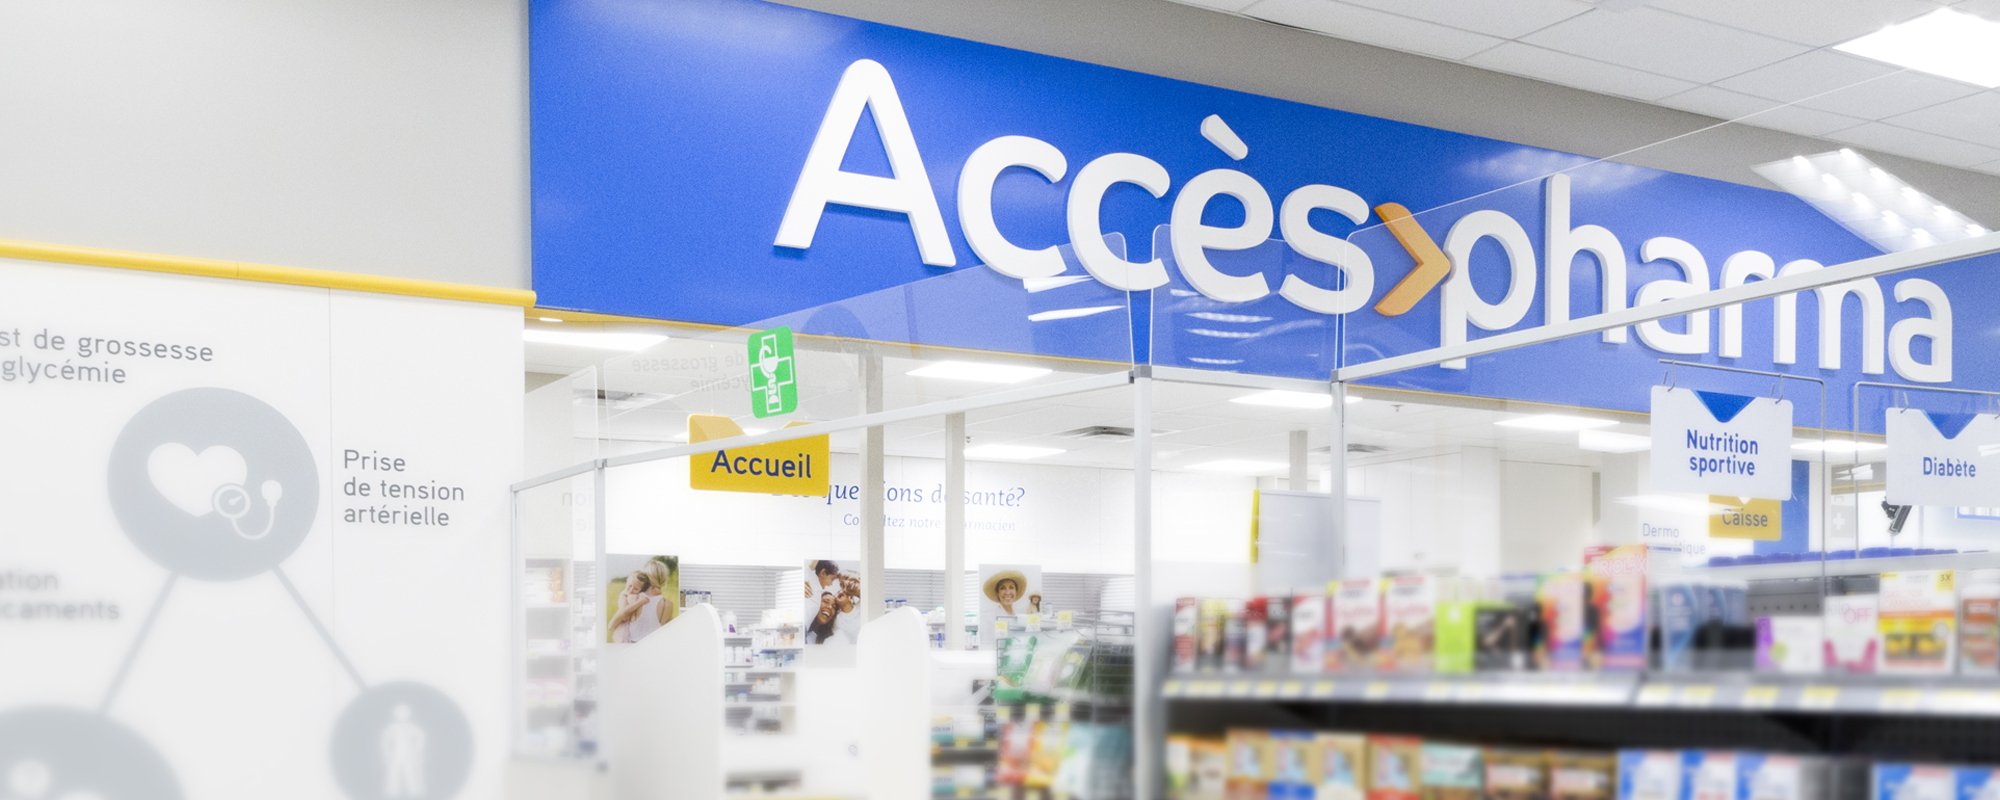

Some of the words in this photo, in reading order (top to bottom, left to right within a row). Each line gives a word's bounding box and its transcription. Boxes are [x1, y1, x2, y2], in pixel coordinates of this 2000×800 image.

[773, 58, 1374, 315] Accès
[1440, 173, 1953, 383] pharma
[33, 328, 65, 351] de
[77, 335, 214, 362] grossesse
[1, 355, 126, 384] glycémie
[1687, 429, 1759, 455] Nutrition
[343, 448, 406, 472] Prise
[710, 449, 812, 478] Accueil
[1689, 454, 1756, 477] sportive
[1923, 457, 1976, 478] Diabète
[343, 476, 371, 497] de
[380, 480, 465, 502] tension
[343, 505, 450, 527] artérielle
[1721, 507, 1769, 528] Caisse
[1642, 522, 1680, 538] Dermo
